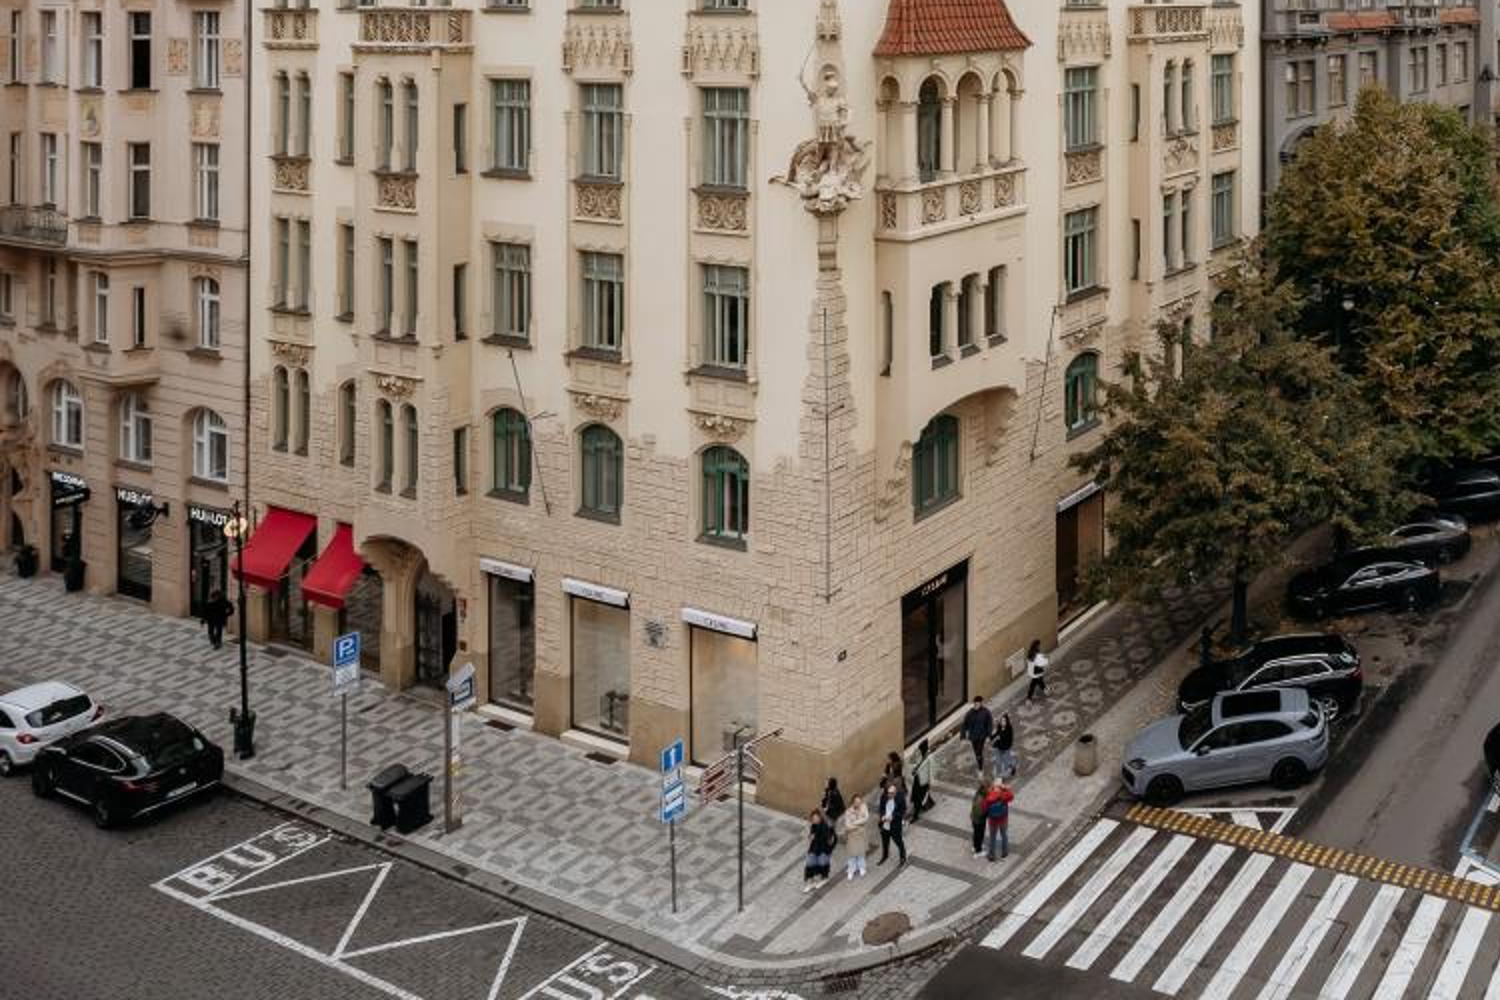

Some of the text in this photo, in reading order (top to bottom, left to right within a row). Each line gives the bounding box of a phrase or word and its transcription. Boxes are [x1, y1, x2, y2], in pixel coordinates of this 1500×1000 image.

[191, 507, 227, 525] HULOT
[178, 827, 317, 892] BUS
[541, 953, 639, 1000] US
